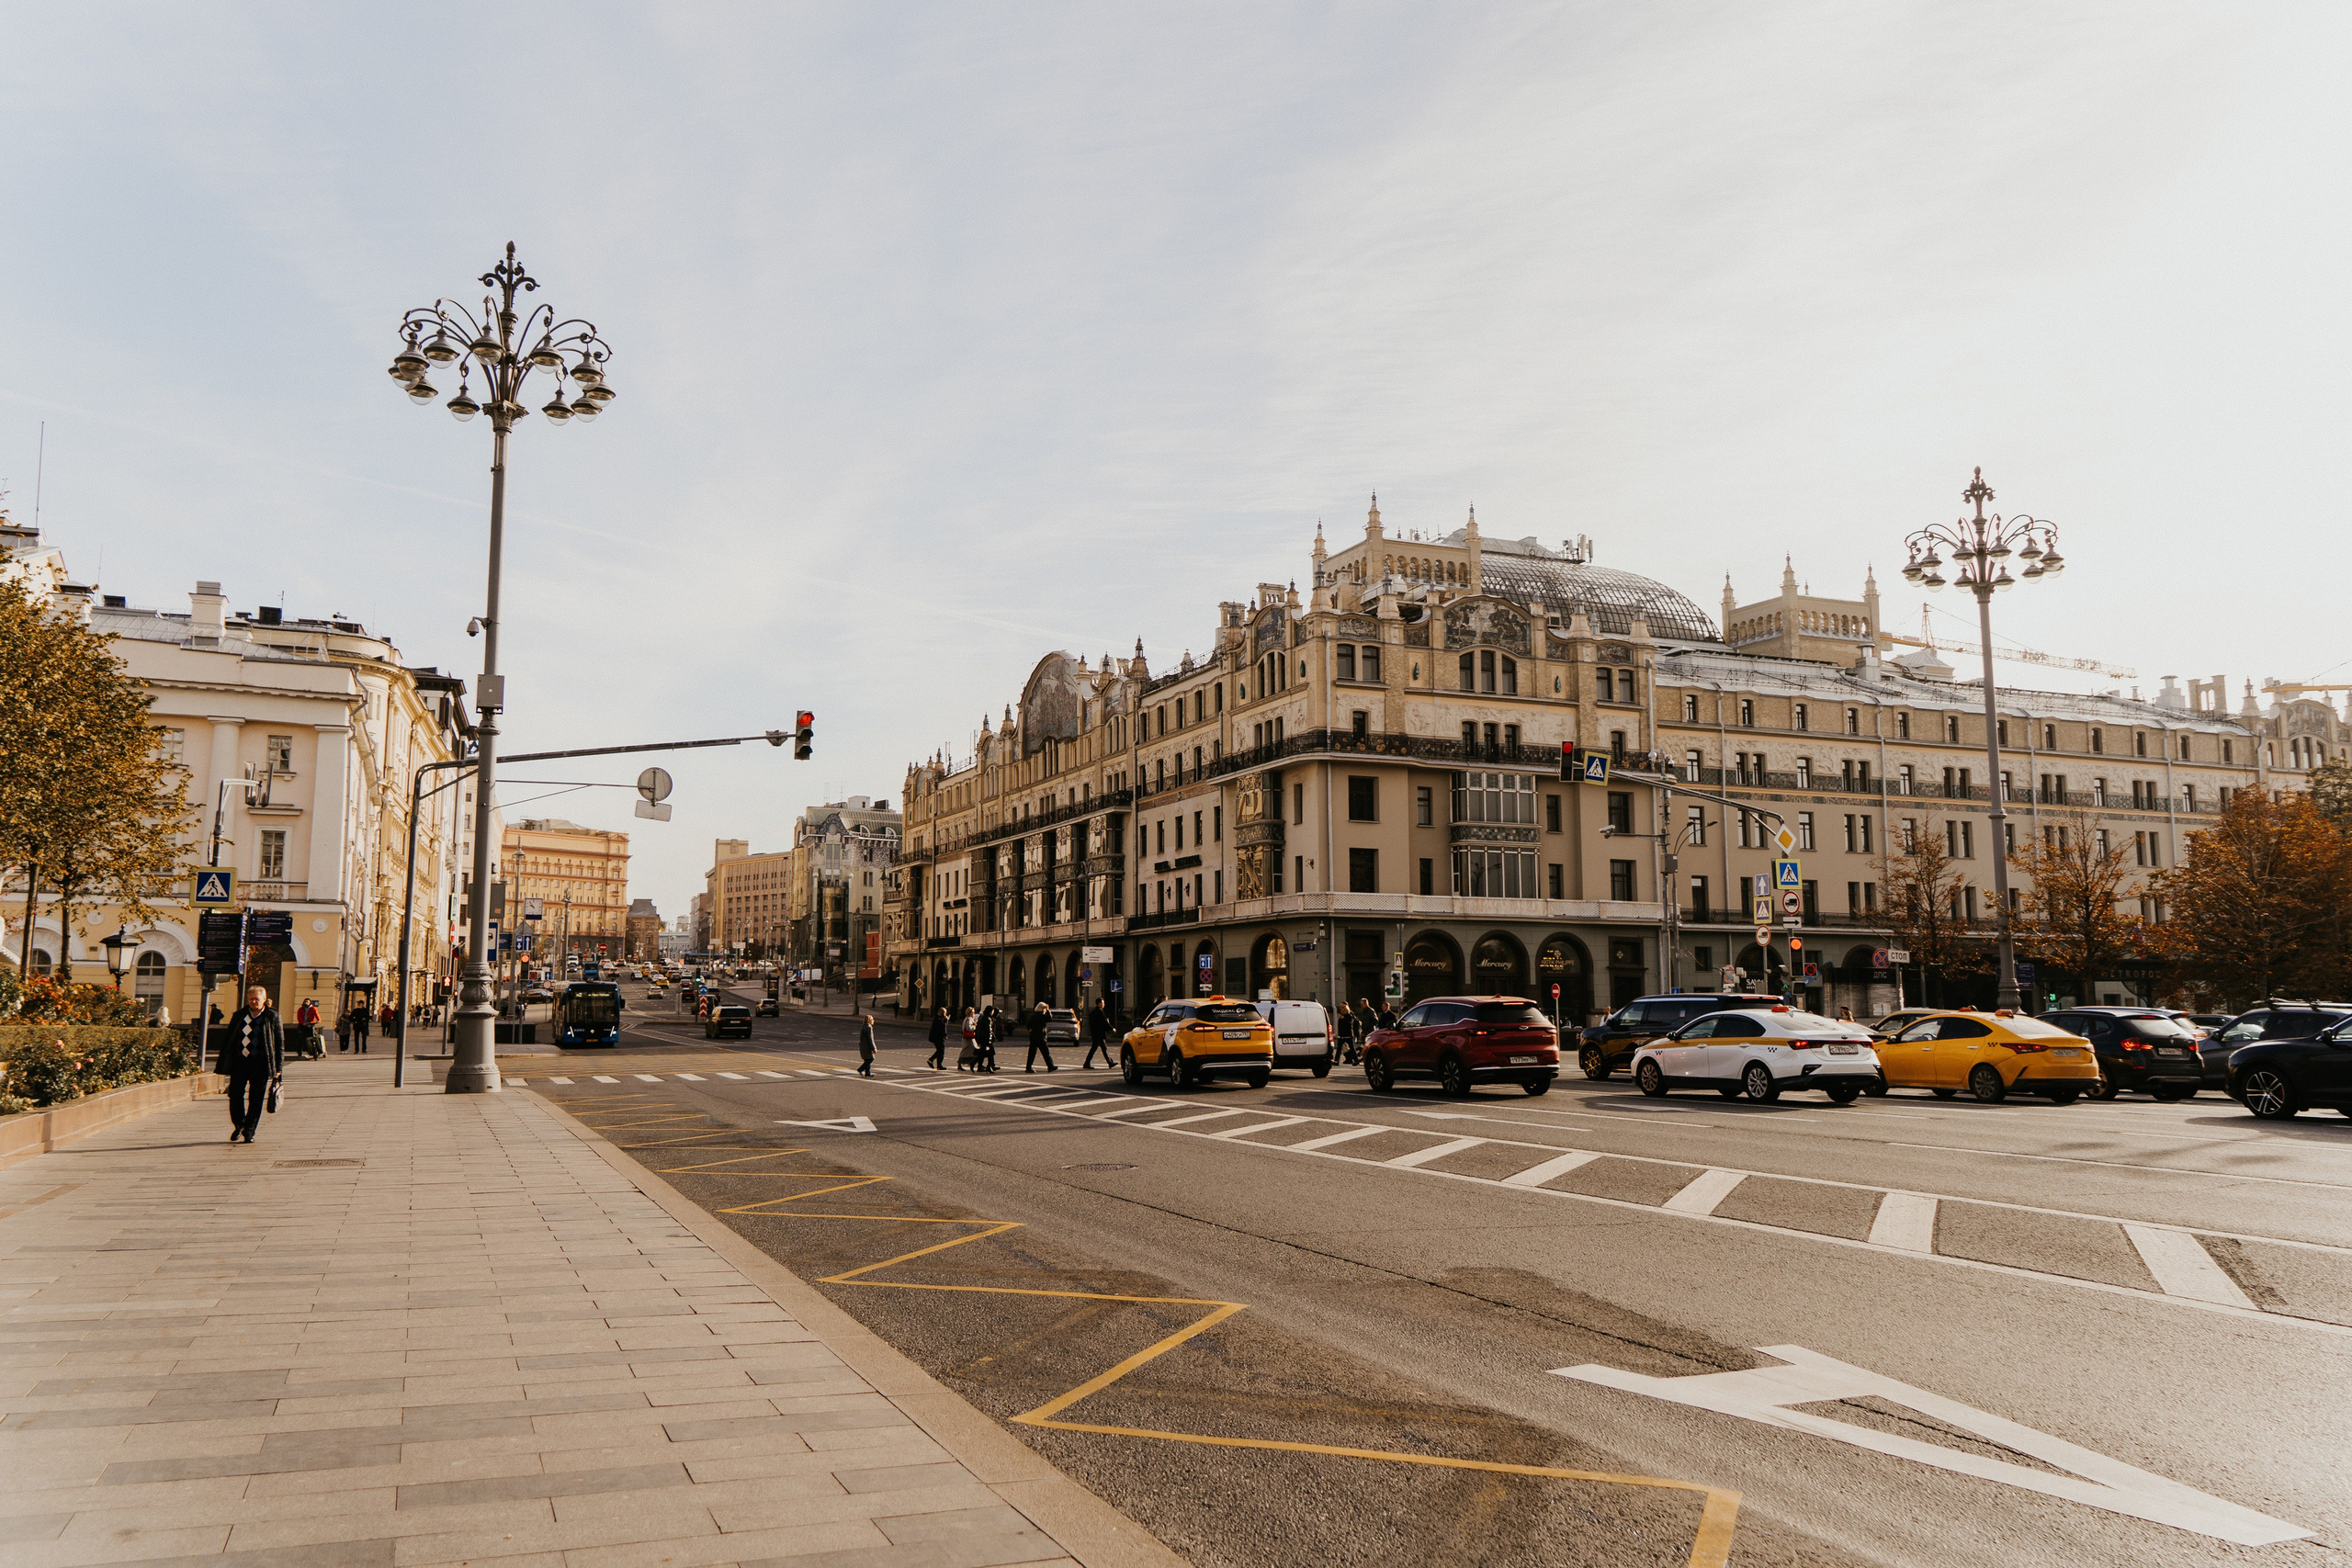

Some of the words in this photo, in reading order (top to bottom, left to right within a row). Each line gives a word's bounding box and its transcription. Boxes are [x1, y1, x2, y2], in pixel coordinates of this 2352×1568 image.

[1891, 952, 1907, 961] СТОП
[1409, 958, 1447, 970] Mercury
[1476, 958, 1512, 970] Mercury
